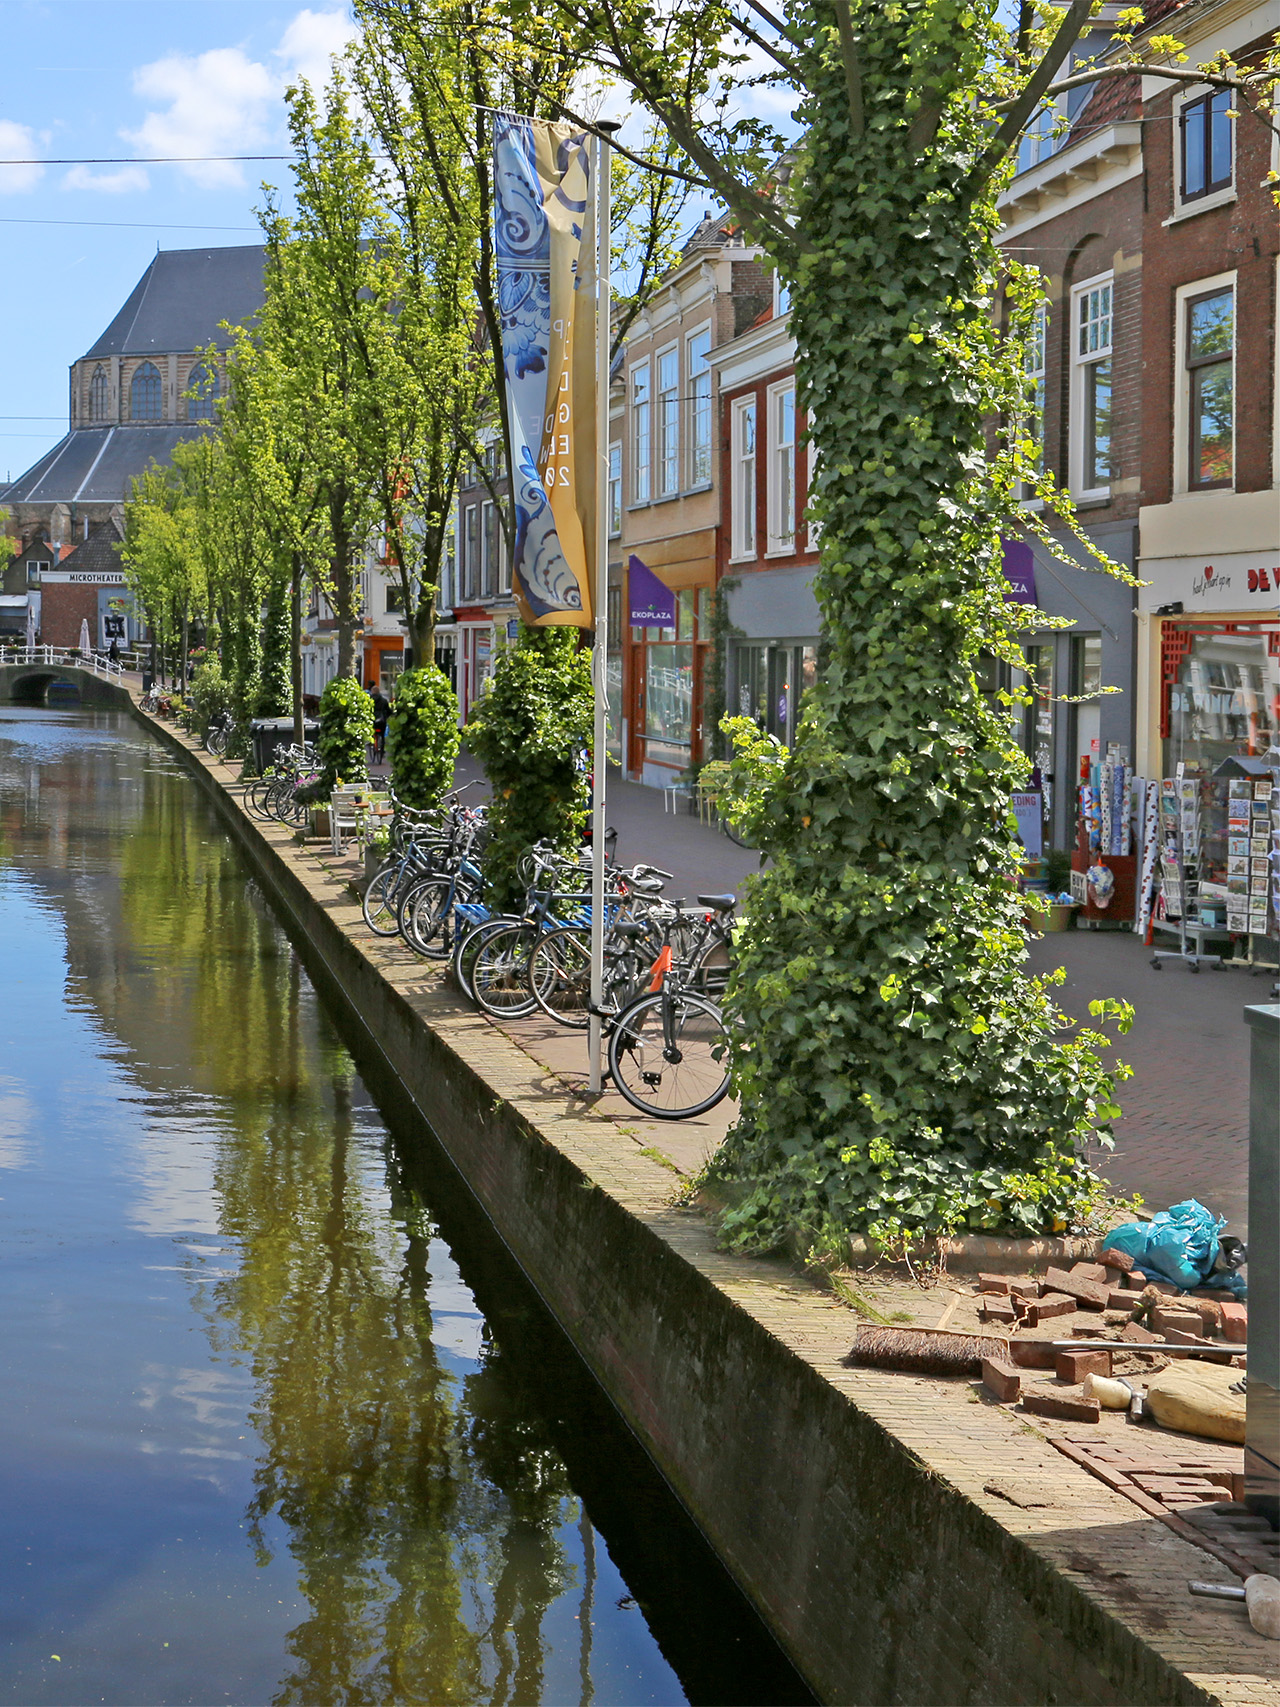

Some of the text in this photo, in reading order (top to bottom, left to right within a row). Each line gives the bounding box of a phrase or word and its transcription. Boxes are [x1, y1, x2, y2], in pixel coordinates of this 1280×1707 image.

[69, 574, 123, 582] MICROTHEATER
[1248, 568, 1270, 592] DE
[631, 611, 672, 619] EKOPLAZA
[1172, 692, 1189, 712] DE
[1011, 796, 1036, 806] EDING
[1072, 874, 1084, 889] BUY
